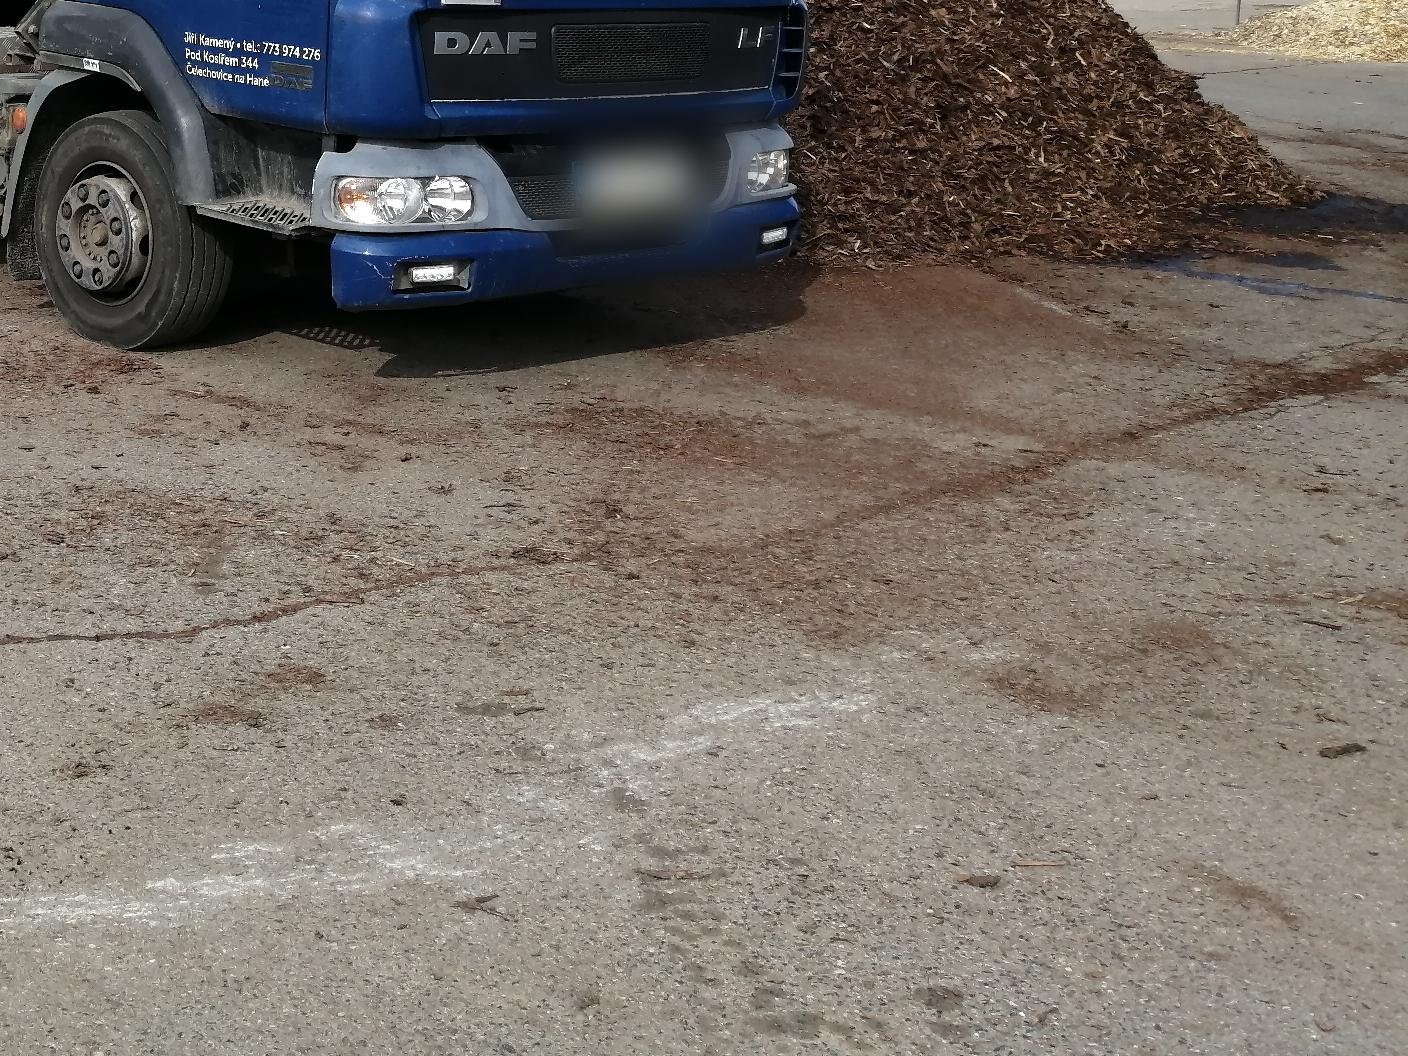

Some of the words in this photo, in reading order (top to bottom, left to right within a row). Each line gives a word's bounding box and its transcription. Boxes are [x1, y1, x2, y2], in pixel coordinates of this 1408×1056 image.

[199, 34, 235, 52] Kamený
[263, 42, 280, 56] 773
[282, 45, 300, 59] 974
[302, 47, 321, 61] 276
[433, 31, 537, 55] DAF
[185, 48, 201, 61] Pod
[240, 56, 259, 70] 344
[234, 74, 245, 84] na
